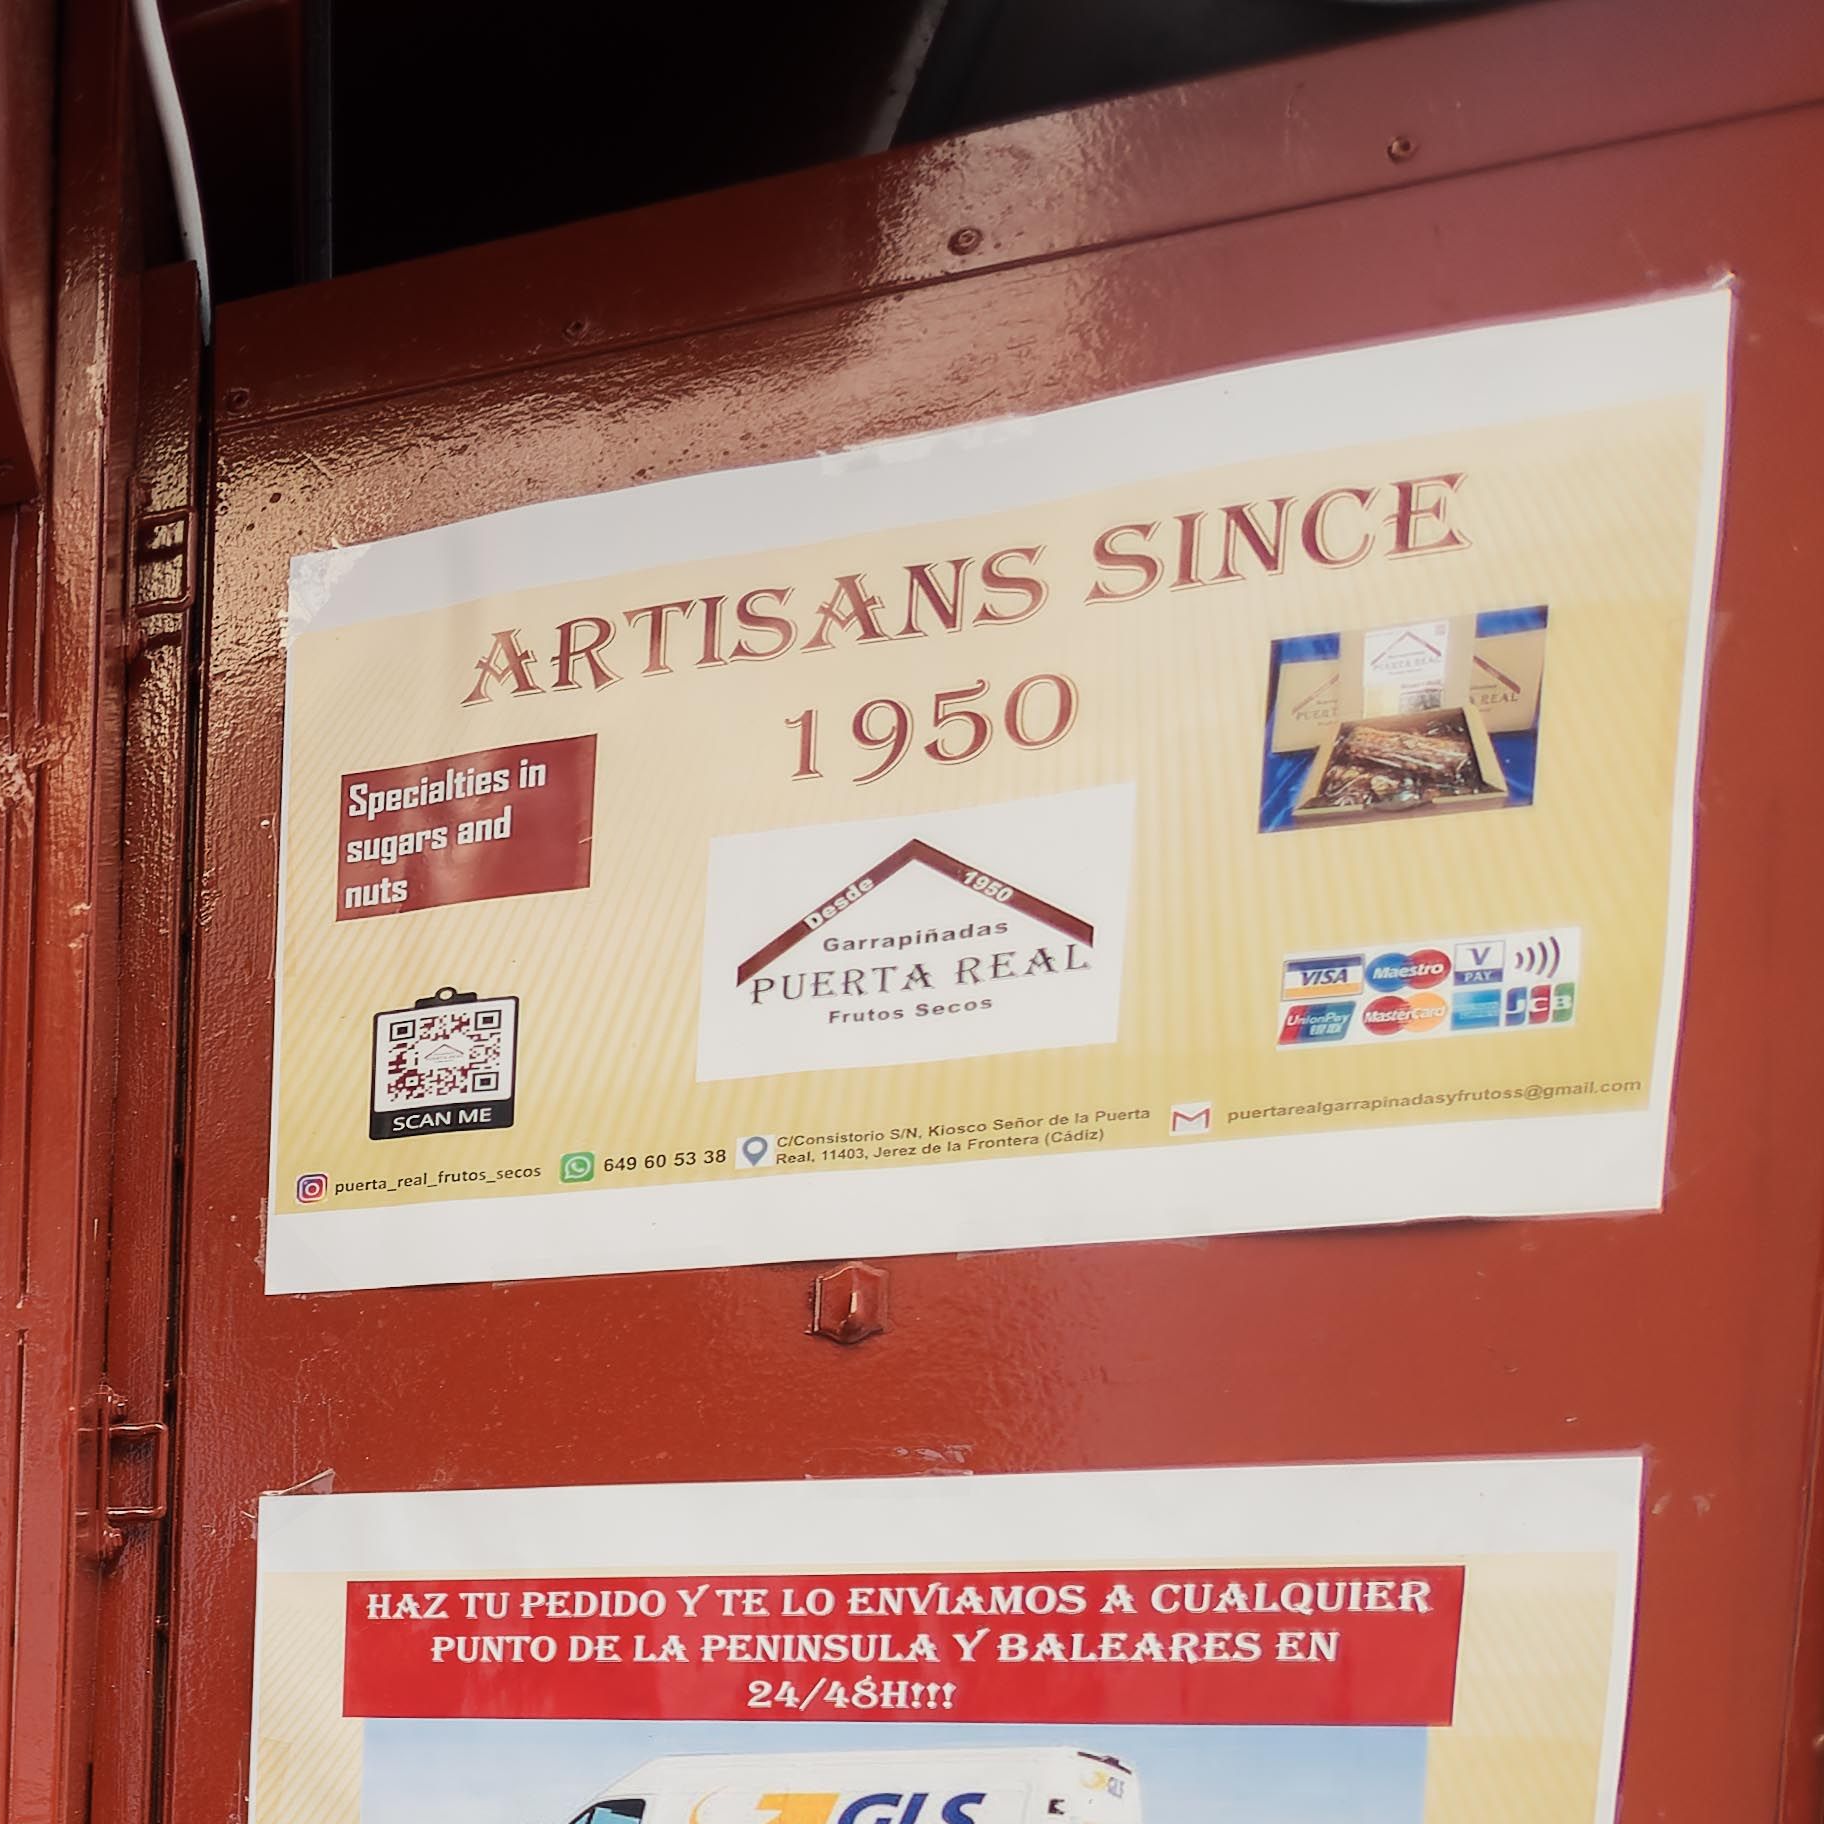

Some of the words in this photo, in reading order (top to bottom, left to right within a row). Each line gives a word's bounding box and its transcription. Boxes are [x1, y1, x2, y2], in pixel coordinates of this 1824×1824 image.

[460, 544, 1048, 706] ARTISANS
[1084, 472, 1472, 606] SINCE
[784, 672, 1080, 786] 1950
[348, 763, 510, 818] Specialties
[519, 758, 547, 791] in
[346, 822, 447, 865] sugars
[457, 806, 512, 845] and
[345, 877, 407, 910] nuts
[963, 871, 1013, 902] 1950
[804, 877, 874, 931] Desde
[823, 921, 1008, 955] Garrapiñadas
[1468, 947, 1491, 965] V
[751, 963, 936, 1005] PUERTA
[955, 944, 1092, 987] REAL
[1301, 969, 1348, 986] VISA
[1373, 963, 1444, 984] Maestro
[1464, 971, 1492, 982] PAY
[829, 1007, 904, 1024] Frutos
[915, 998, 993, 1018] Secos
[1287, 1010, 1350, 1026] UnionPay
[1364, 1006, 1446, 1023] MasterCard
[1227, 1076, 1642, 1124] puertarealgarrapinadasyfrutoss@gmail.com
[392, 1111, 450, 1133] SCAN
[456, 1107, 492, 1126] ME
[777, 1131, 884, 1149] C/Consistorio
[889, 1126, 922, 1141] S/N,
[928, 1119, 987, 1138] Kiosco
[993, 1114, 1043, 1132] Señor
[1049, 1112, 1069, 1127] de
[1074, 1111, 1089, 1125] la
[1095, 1106, 1150, 1124] Puerta
[604, 1155, 638, 1173] 649
[644, 1152, 668, 1171] 60
[673, 1150, 697, 1169] 53
[703, 1148, 727, 1166] 38
[776, 1150, 815, 1167] Real,
[822, 1146, 868, 1162] 11403,
[874, 1142, 916, 1160] Jerez
[922, 1140, 941, 1155] de
[946, 1138, 962, 1153] la
[968, 1132, 1039, 1152] Frontera
[1044, 1127, 1105, 1148] (Cádiz)
[334, 1165, 542, 1198] puerta_real_frutos_secos
[367, 1590, 449, 1620] HAZ
[459, 1590, 509, 1619] TU
[521, 1588, 667, 1619] PEDIDO
[678, 1584, 711, 1617] Y
[717, 1588, 768, 1617] TE
[781, 1587, 834, 1617] LO
[847, 1582, 1088, 1617] ENVIAMOS
[1100, 1584, 1136, 1615] A
[1151, 1580, 1433, 1615] CUALQUIER
[431, 1634, 557, 1663] PUNTO
[568, 1634, 622, 1662] DE
[633, 1634, 689, 1663] LA
[700, 1632, 941, 1663] PENINSULA
[952, 1627, 989, 1662] Y
[997, 1630, 1262, 1664] BALEARES
[1275, 1630, 1340, 1662] EN
[746, 1675, 956, 1711] 24/48H!!!
